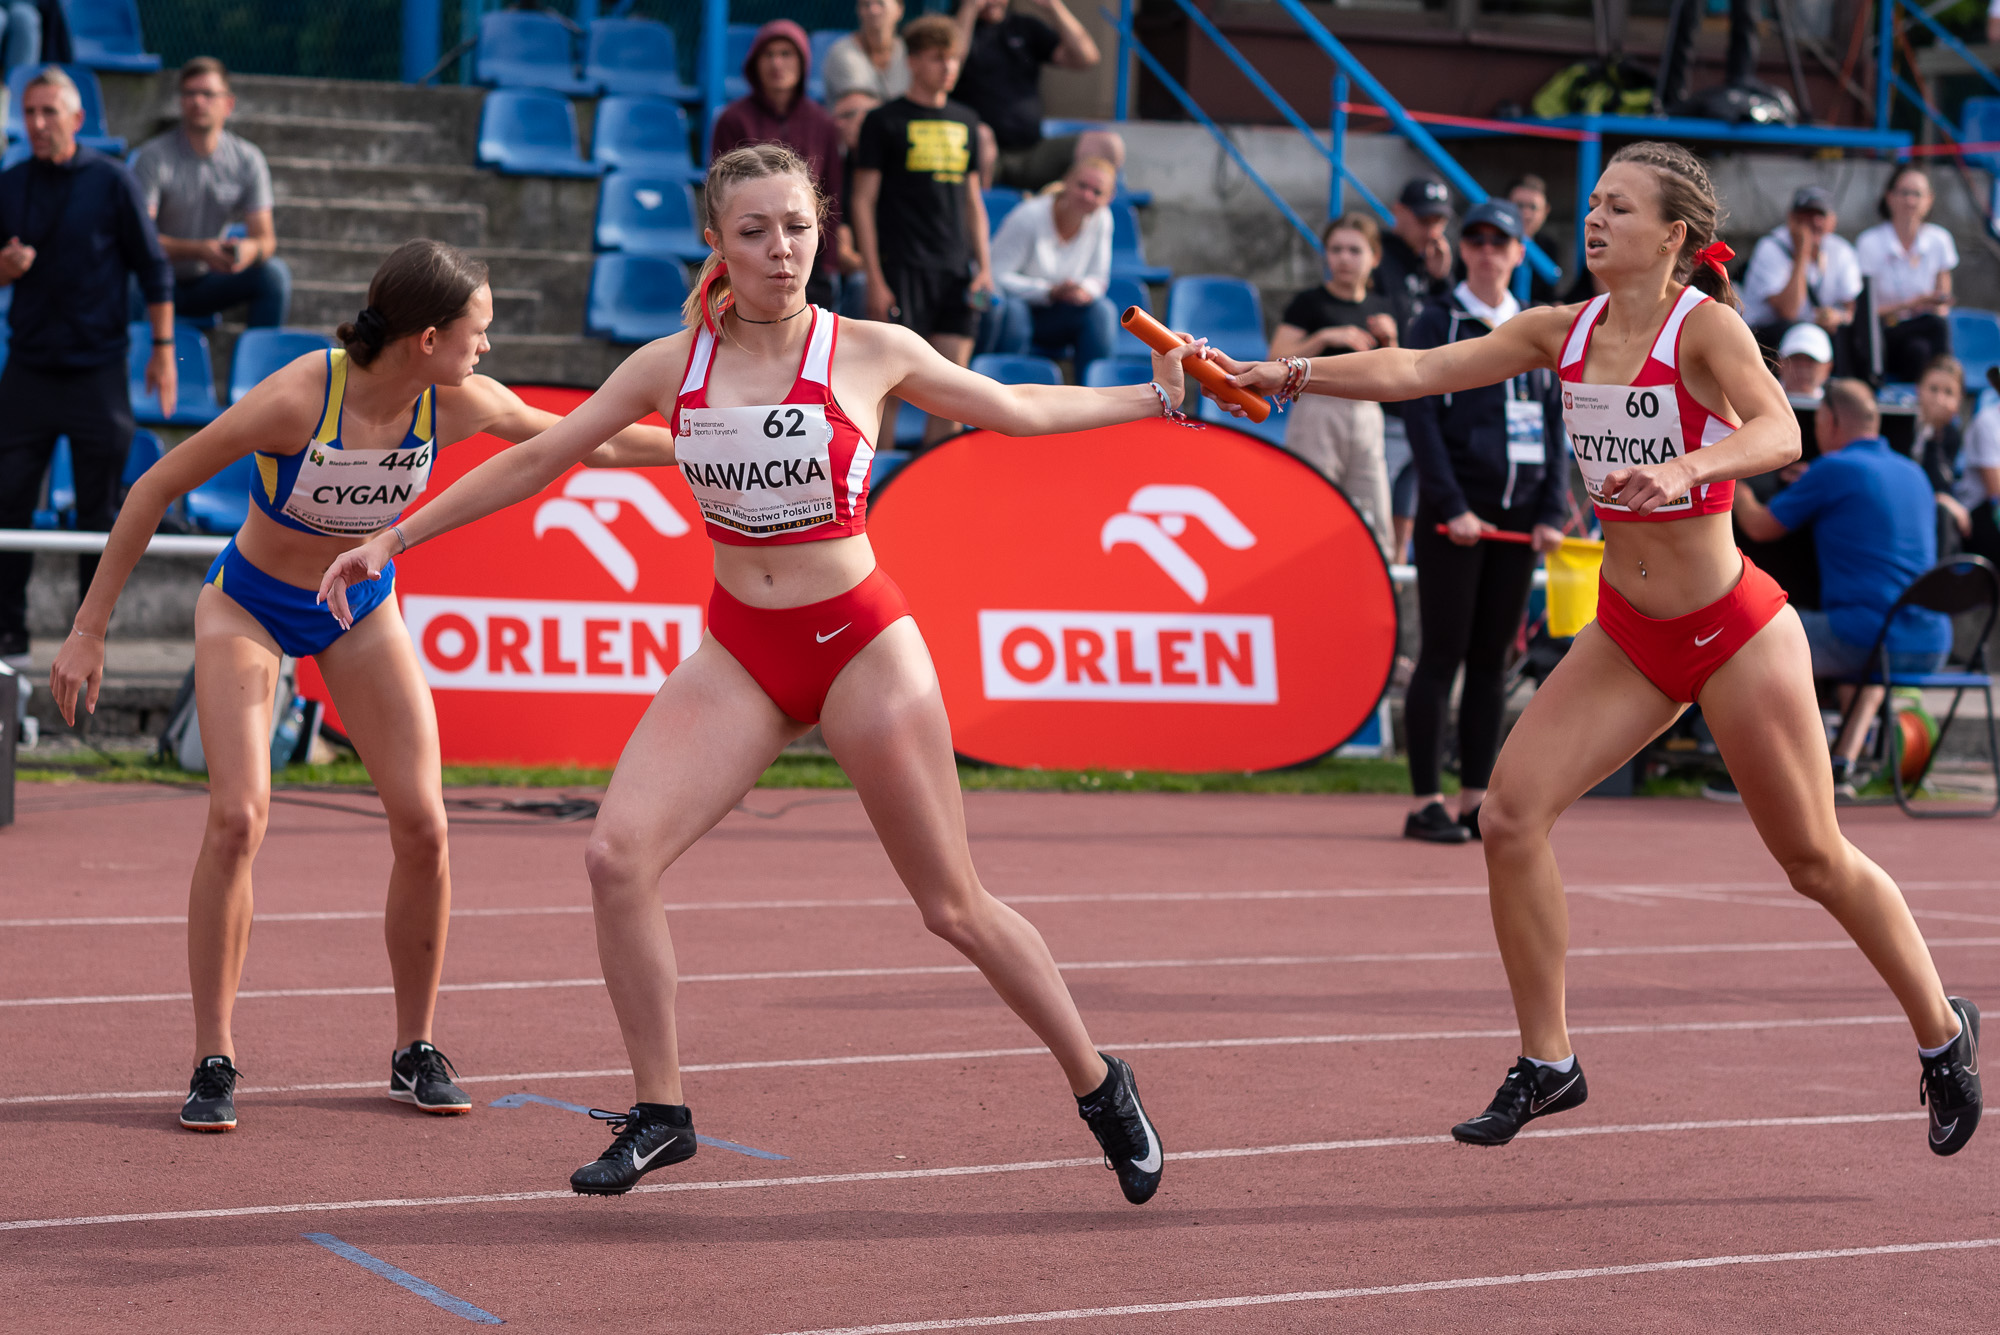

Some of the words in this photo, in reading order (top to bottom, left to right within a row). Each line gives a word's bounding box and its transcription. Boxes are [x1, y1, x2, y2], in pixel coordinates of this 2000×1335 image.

[1625, 391, 1660, 418] 60
[763, 408, 806, 438] 62
[378, 446, 430, 471] 446
[1572, 428, 1679, 465] CZYŻYCKA
[683, 457, 826, 491] NAWACKA
[312, 483, 413, 505] CYGAN
[325, 519, 374, 528] Mistrzostwa
[713, 503, 731, 515] PZLA
[732, 508, 780, 523] Mistrzostwa
[783, 505, 811, 518] Polski
[814, 501, 832, 512] U18
[767, 514, 831, 532] 15-17.07.2022
[421, 612, 681, 677] ORLEN
[1001, 626, 1256, 688] ORLEN
